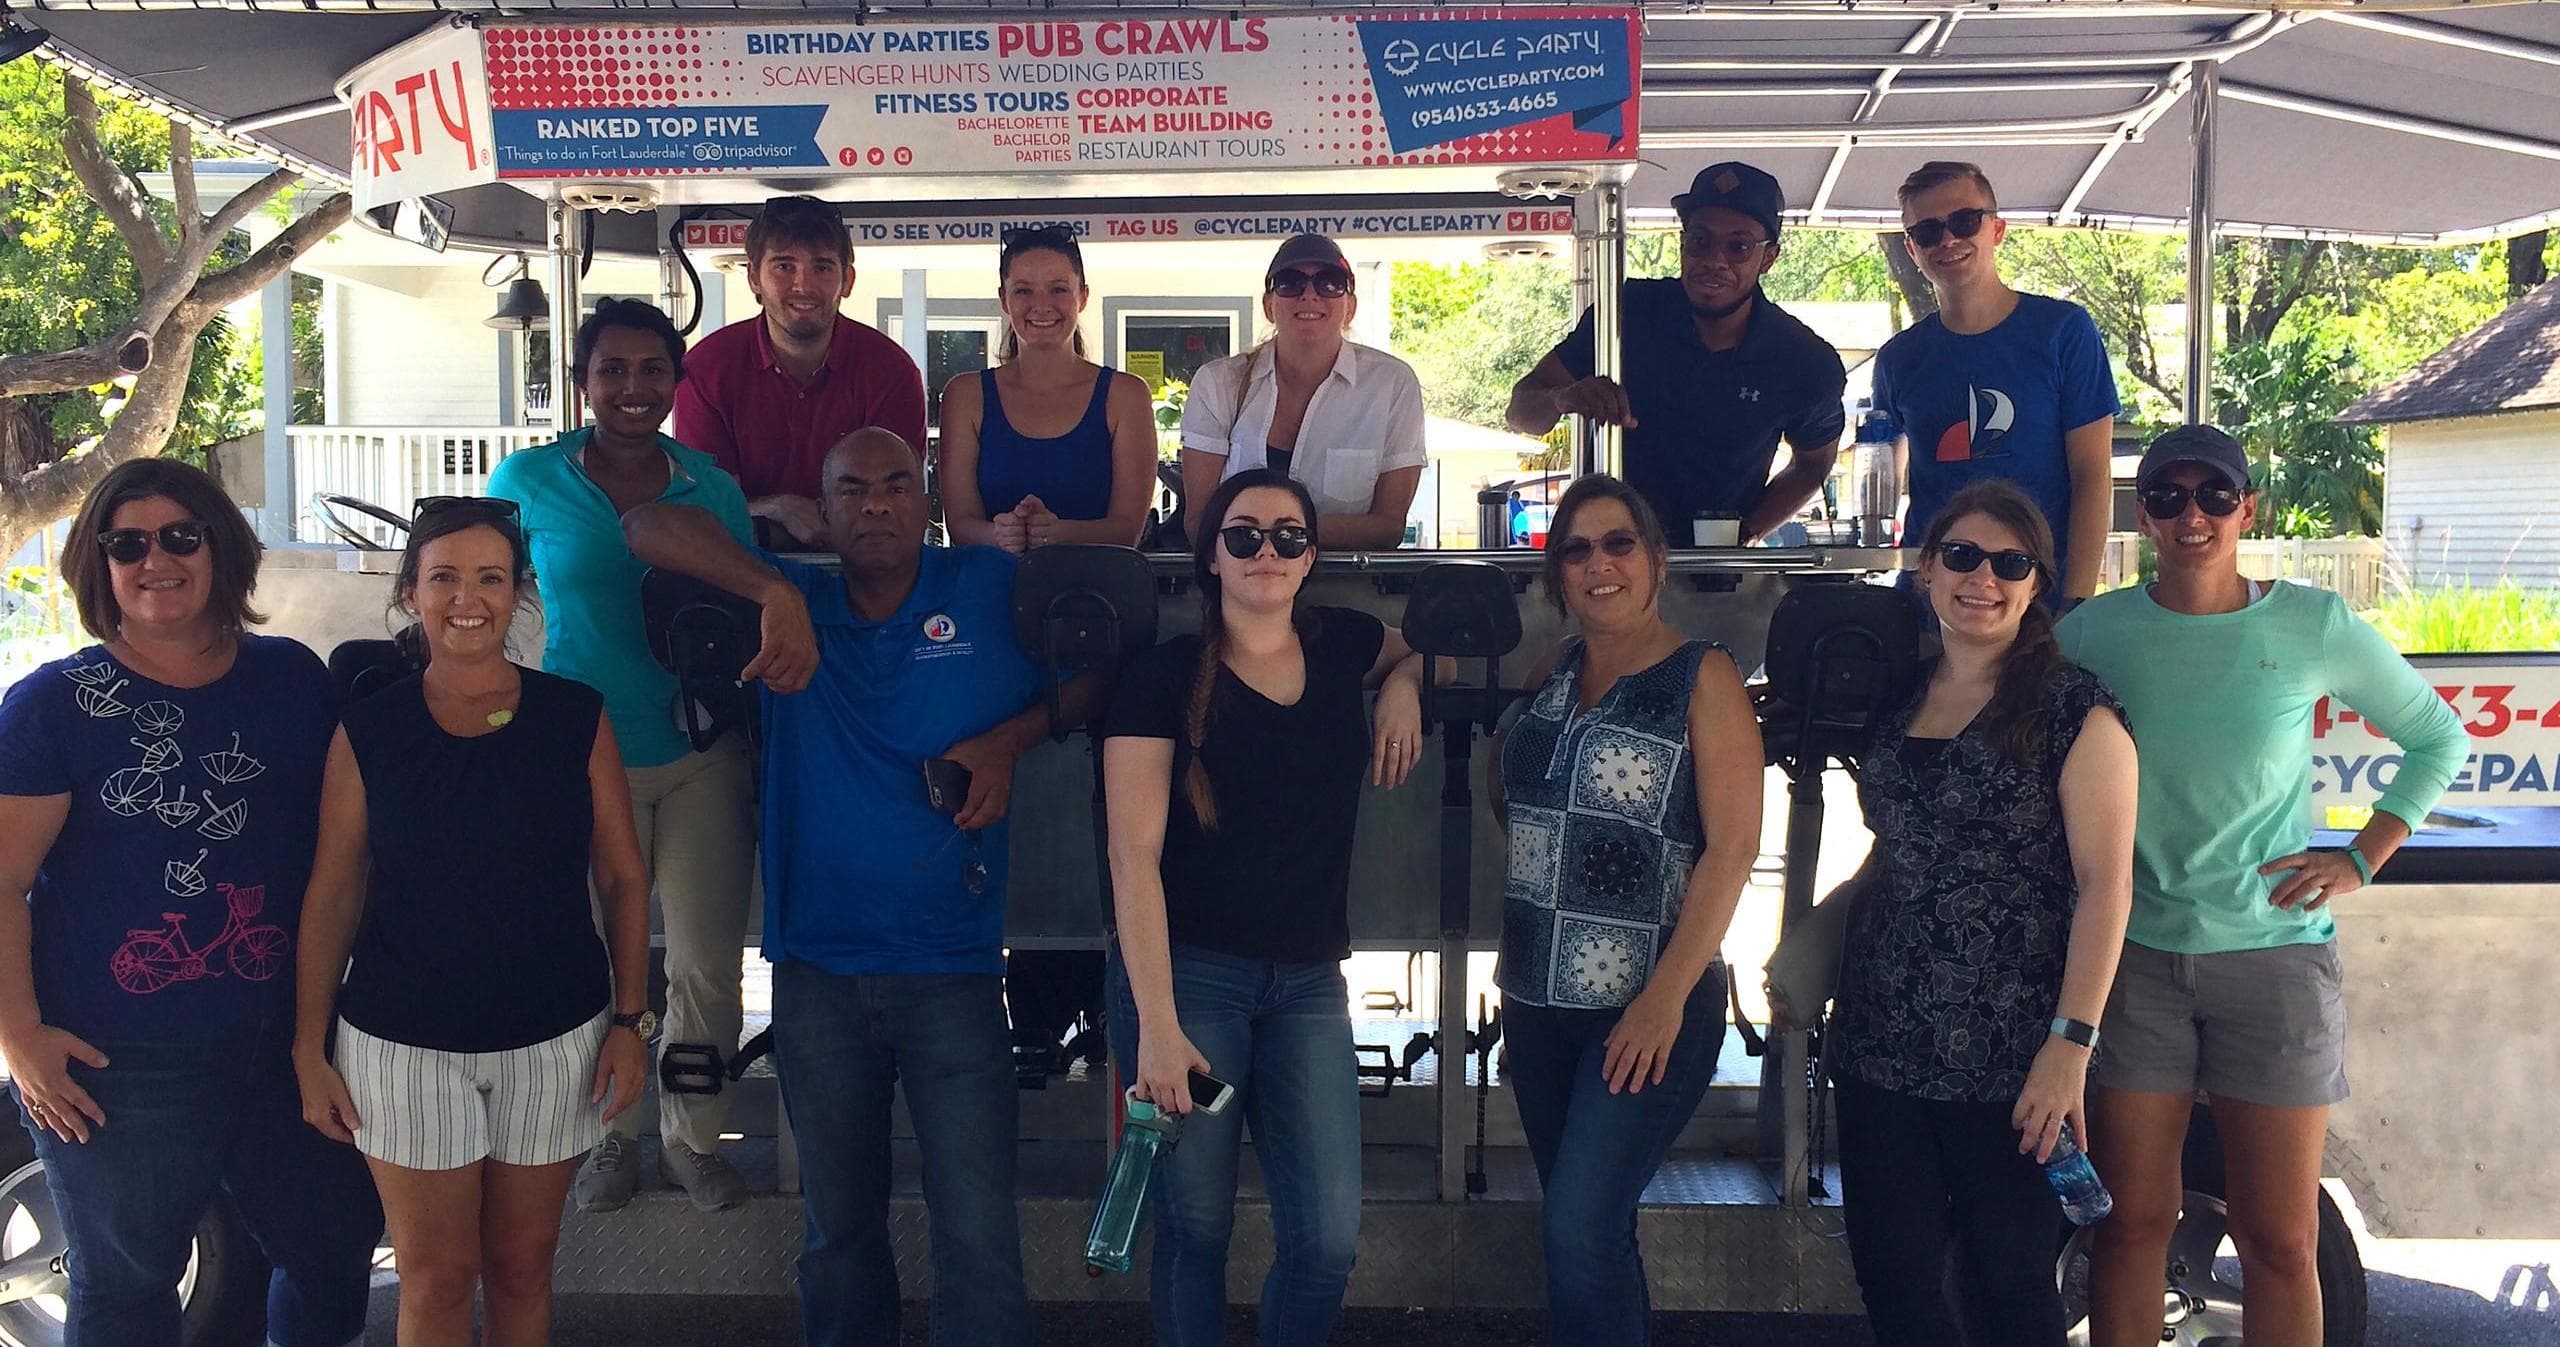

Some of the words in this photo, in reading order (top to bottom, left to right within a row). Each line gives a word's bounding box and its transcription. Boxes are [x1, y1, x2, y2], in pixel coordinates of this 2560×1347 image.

[747, 32, 875, 54] BIRTHDAY
[884, 30, 990, 52] PARTIES
[998, 23, 1083, 58] PUB
[1095, 18, 1269, 55] CRAWLS
[1425, 38, 1506, 66] CYCLE
[762, 64, 904, 86] SCAVENGER
[911, 62, 990, 84] HUNTS
[999, 63, 1109, 83] WEDDING
[1117, 61, 1204, 82] PARTIES
[1404, 63, 1604, 98] WWW.CYCLEPARTY.COM
[875, 92, 977, 114] FITNESS
[984, 91, 1070, 113] TOURS
[1076, 86, 1228, 109] CORPORATE
[1411, 91, 1558, 128] (954)633-4665
[537, 118, 641, 139] RANKED
[646, 117, 698, 137] TOP
[704, 116, 760, 136] FIVE
[957, 116, 1070, 131] BACHELORETTE
[1077, 114, 1146, 134] TEAM
[1153, 111, 1273, 132] BUILDING
[546, 148, 558, 159] to
[560, 145, 576, 159] do
[578, 147, 589, 159] in
[592, 145, 617, 159] Fort
[993, 133, 1070, 147] BACHELOR
[1079, 140, 1209, 160] RESTAURANT
[1216, 138, 1286, 158] TOURS
[1015, 149, 1072, 163] PARTIES
[860, 224, 887, 240] TO
[894, 224, 930, 239] SEE
[935, 221, 994, 239] YOUR
[1000, 220, 1090, 237] POS!
[1107, 220, 1148, 236] TAG
[1152, 219, 1178, 235] US
[1194, 216, 1346, 236] @CYCLEPARTY
[1352, 214, 1501, 233] #CYCLEPARTY
